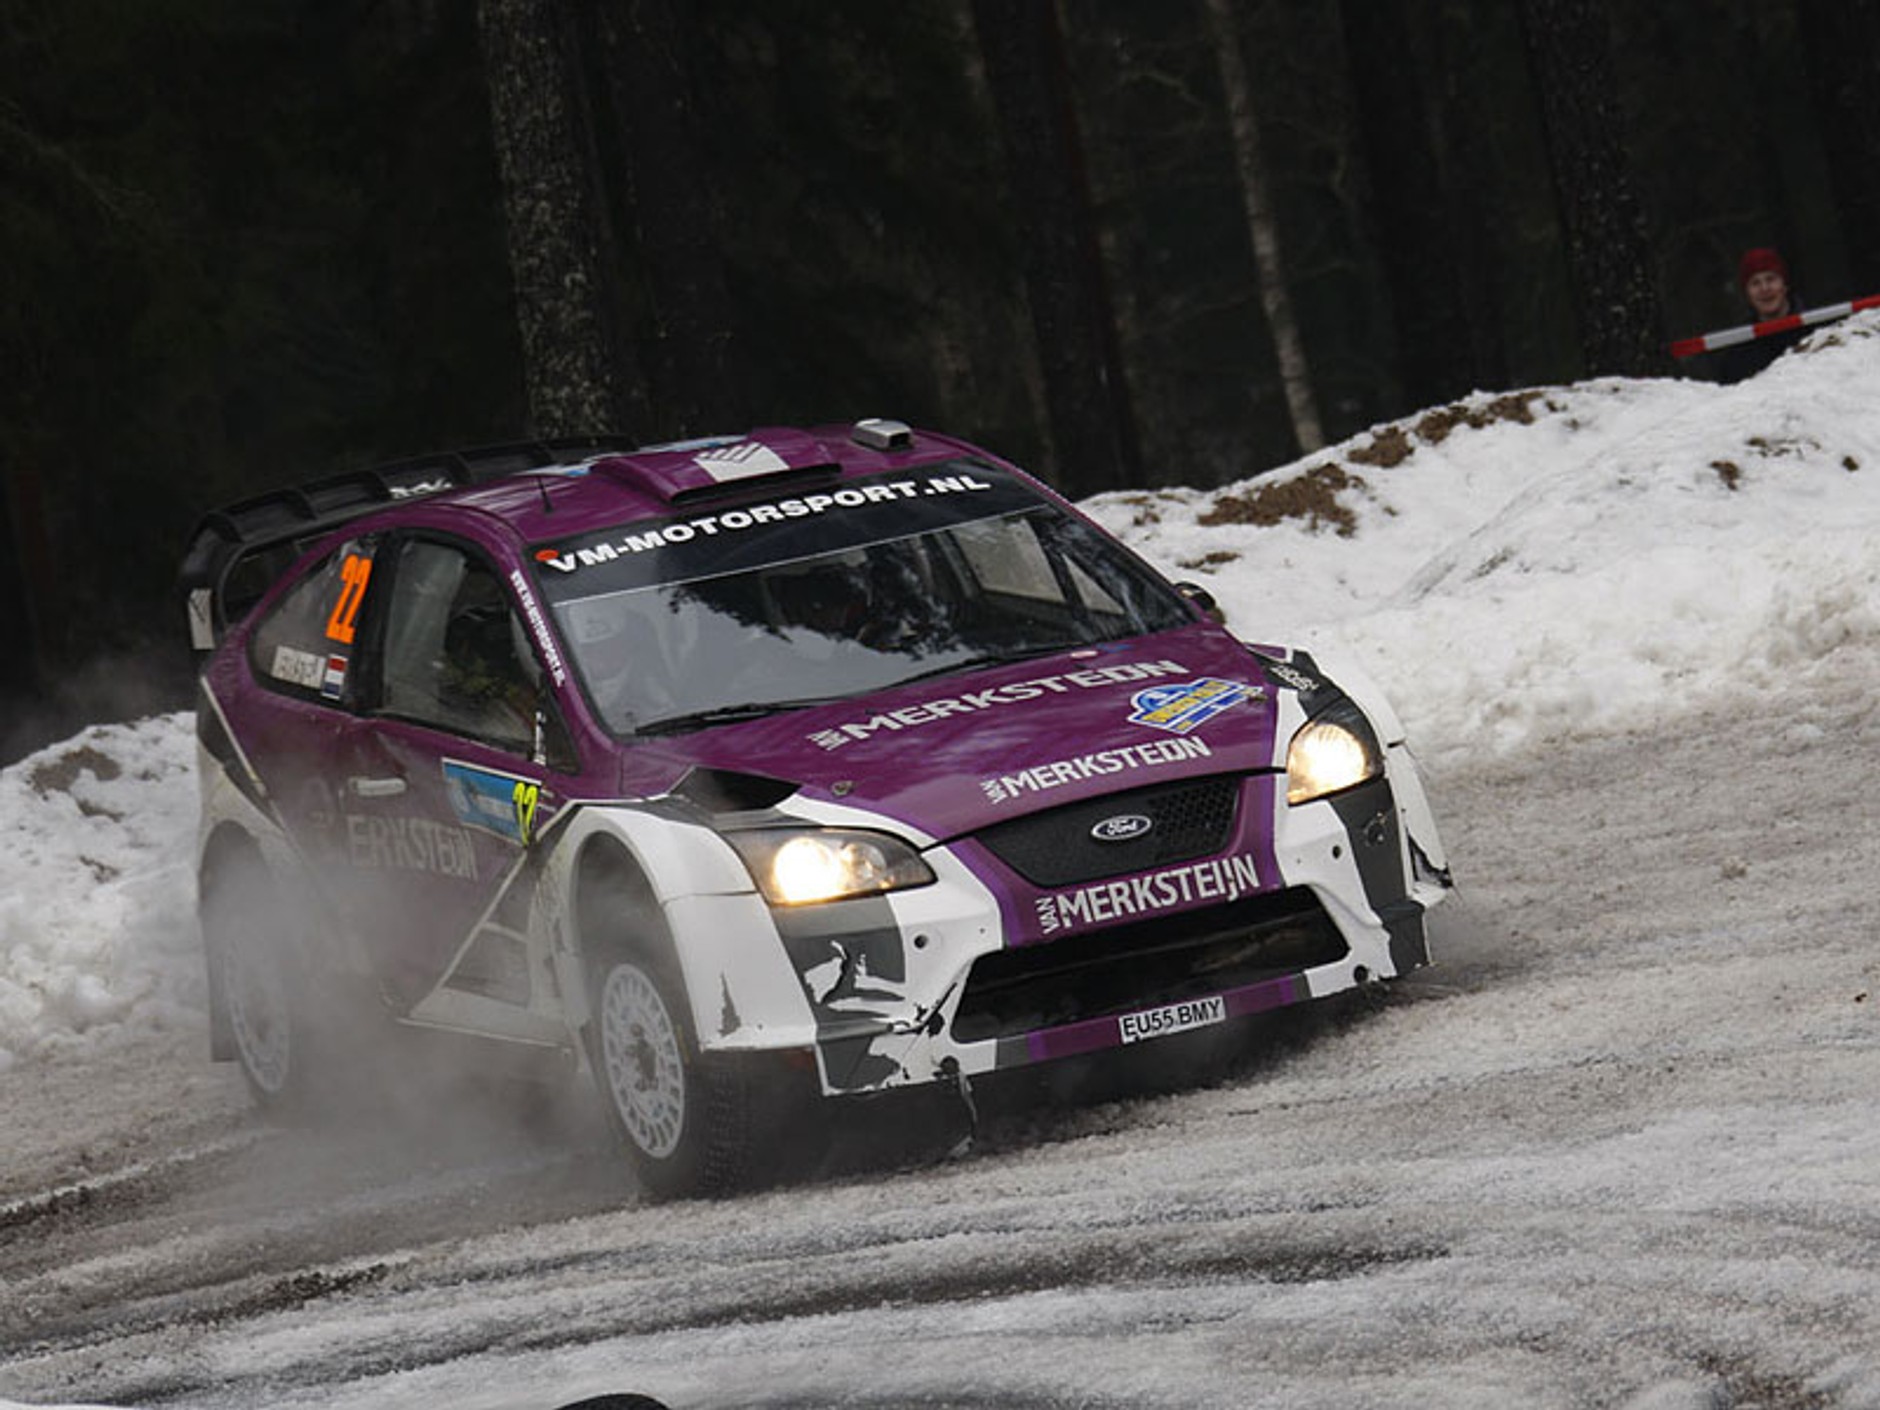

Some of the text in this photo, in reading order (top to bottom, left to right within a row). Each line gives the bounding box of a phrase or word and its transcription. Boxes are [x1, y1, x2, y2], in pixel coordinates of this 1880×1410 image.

[547, 474, 991, 573] VM-MOTORSPORT.NL
[326, 553, 373, 645] 22
[512, 782, 538, 847] 22
[1036, 853, 1261, 935] VAN MERKSTEIJN
[1121, 1000, 1222, 1039] EU55 BMY
